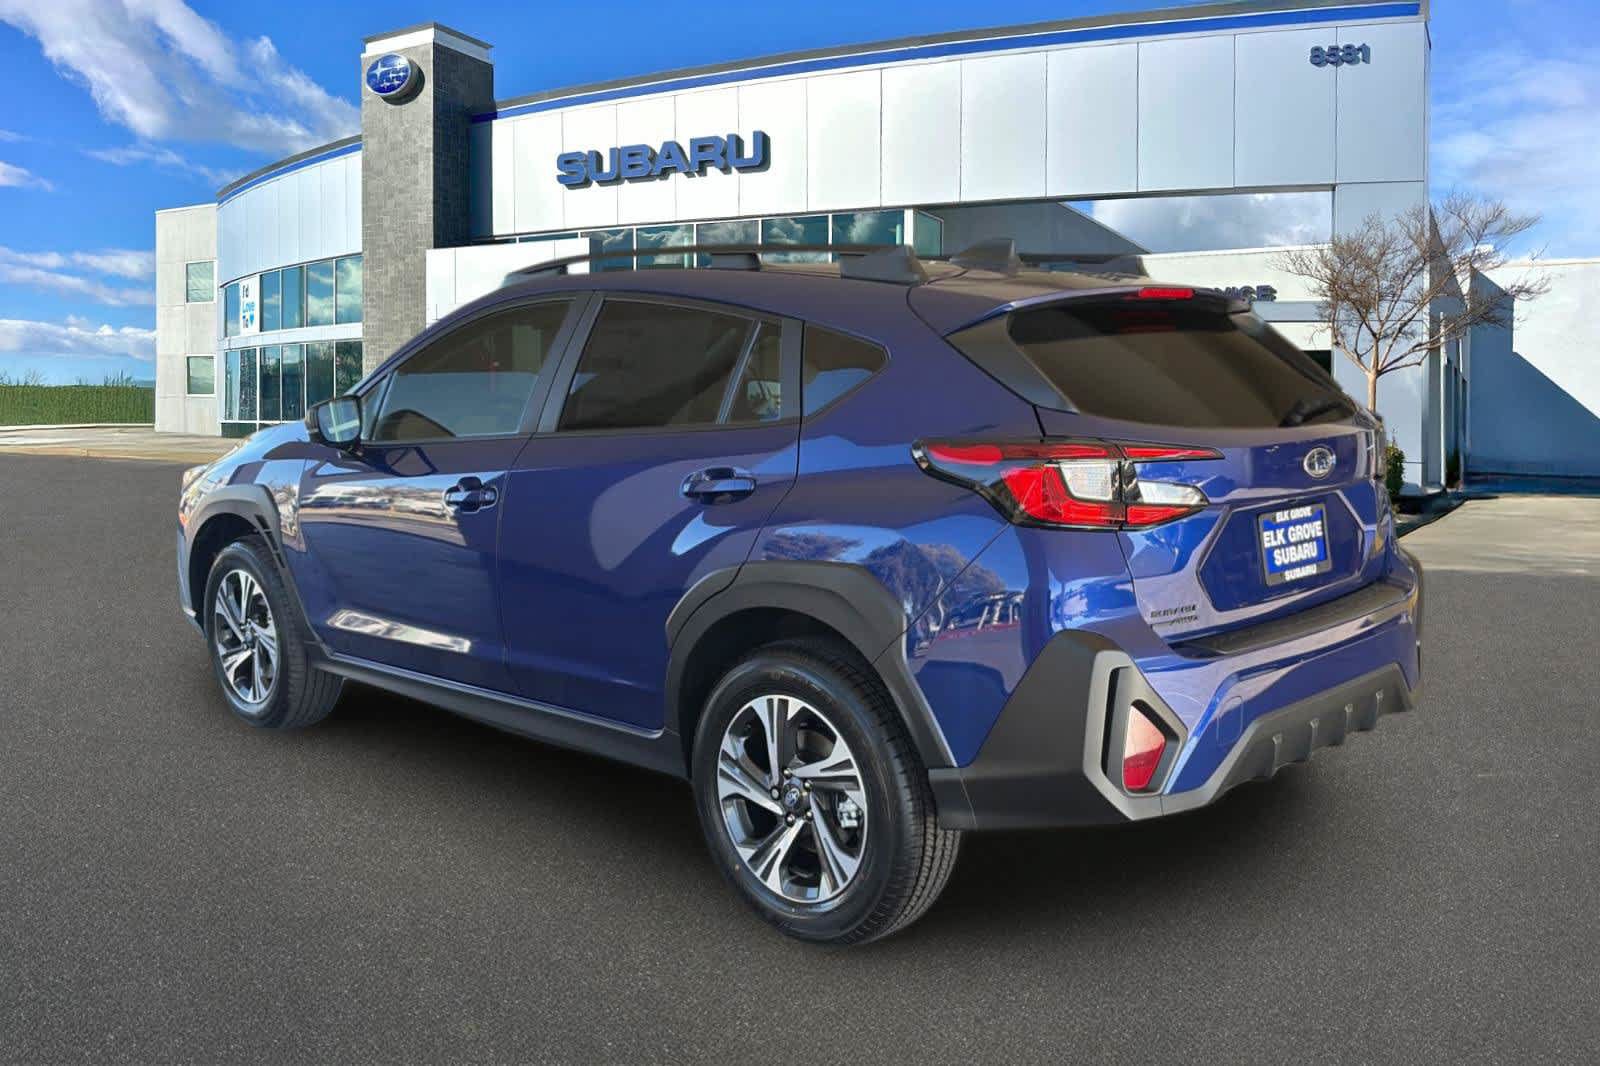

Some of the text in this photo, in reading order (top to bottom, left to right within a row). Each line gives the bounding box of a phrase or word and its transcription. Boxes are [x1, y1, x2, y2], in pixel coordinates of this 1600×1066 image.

[556, 130, 769, 189] SUBARU
[1275, 506, 1312, 523] ELK GROVE
[1263, 520, 1323, 548] ELK GROVE
[1273, 541, 1318, 566] SUBARU
[1284, 564, 1317, 581] SUBARU
